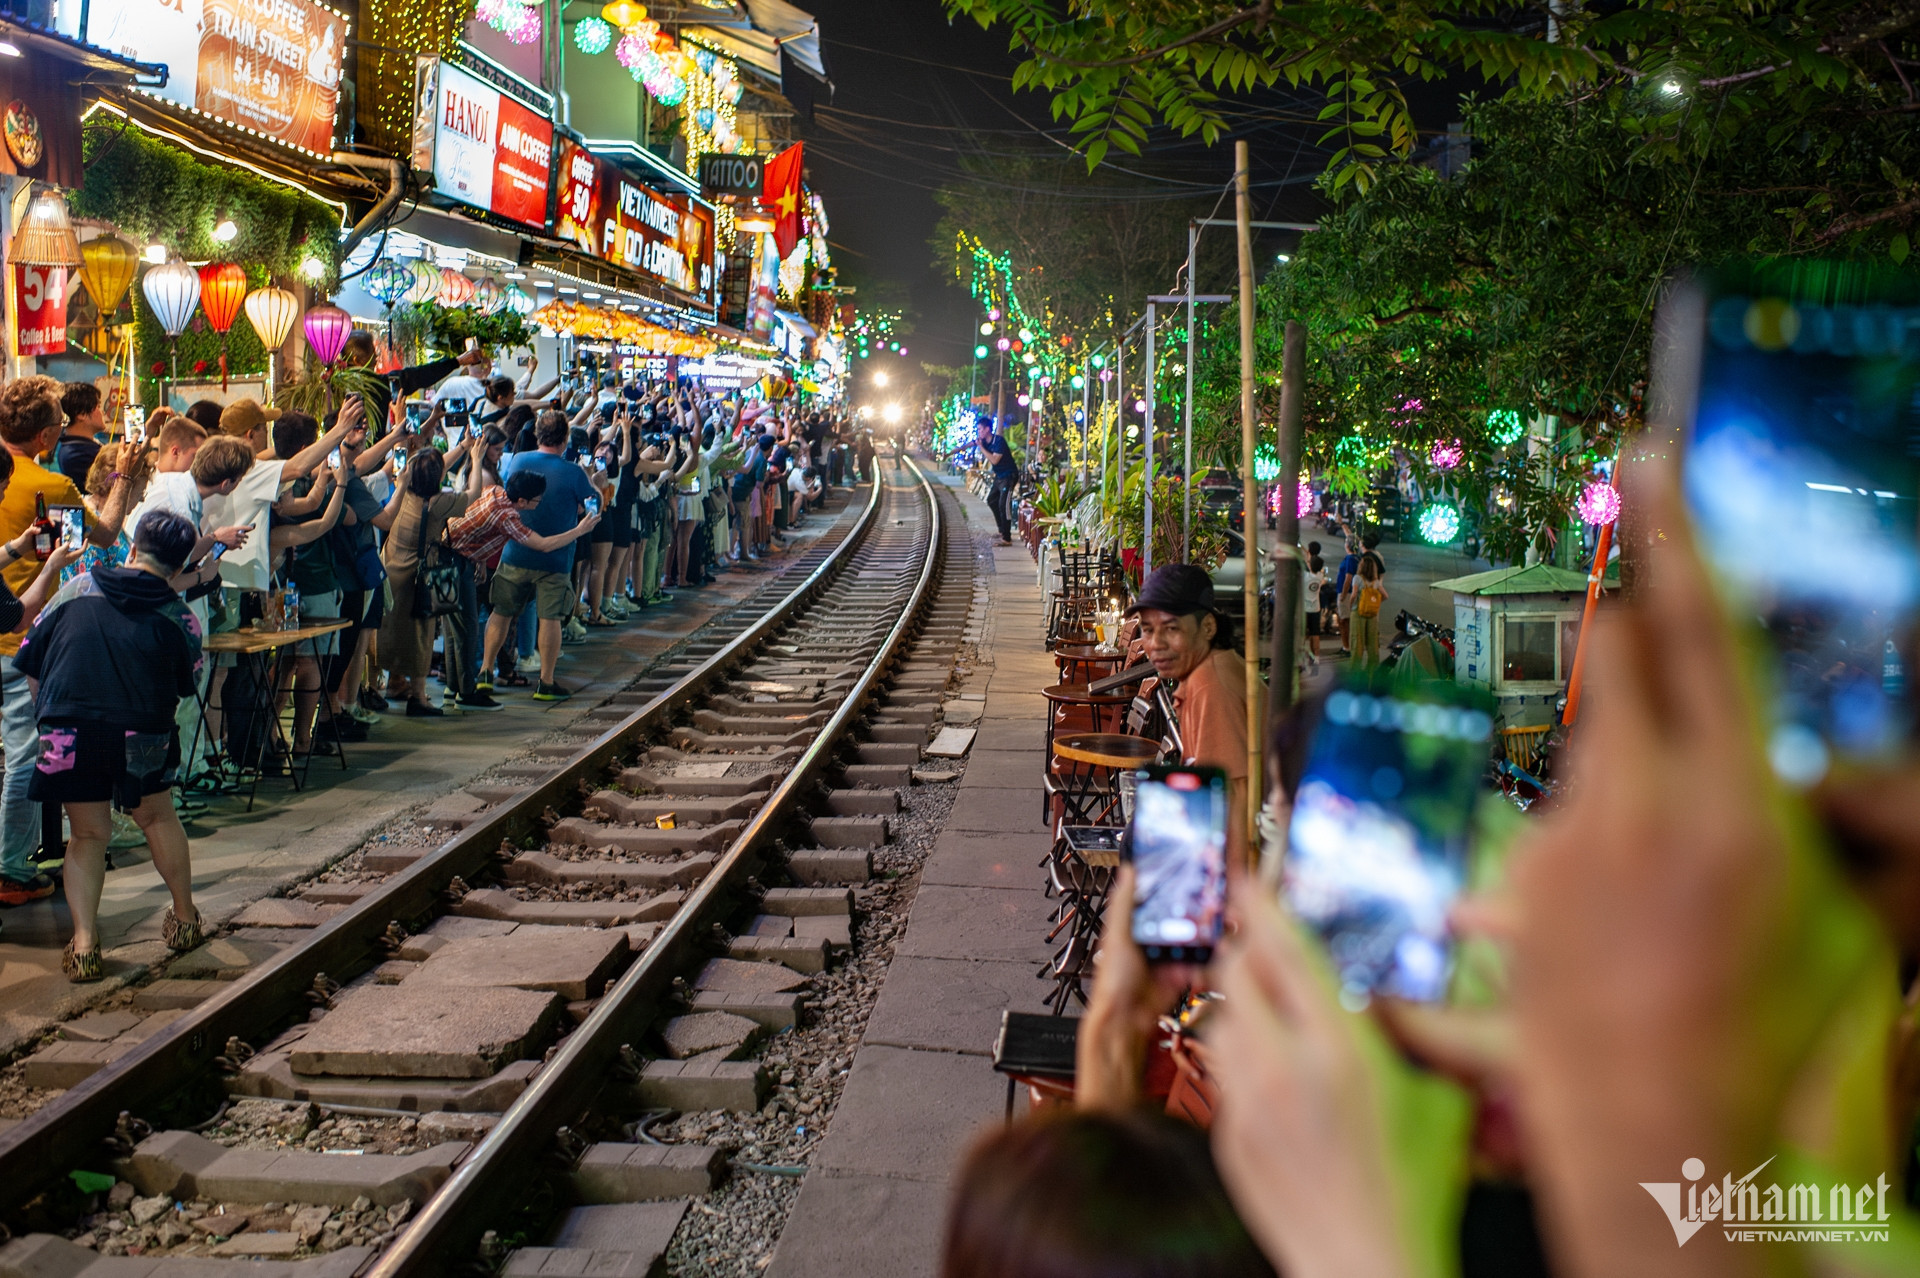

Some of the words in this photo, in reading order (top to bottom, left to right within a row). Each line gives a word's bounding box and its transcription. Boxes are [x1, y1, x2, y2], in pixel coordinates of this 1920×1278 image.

[253, 0, 306, 34] COFFEE
[213, 6, 257, 50] TRAIN
[257, 29, 307, 71] STREET
[232, 54, 251, 86] 54
[262, 69, 280, 98] 58
[444, 89, 490, 144] HANOI
[520, 133, 551, 169] COFFEE
[704, 158, 759, 188] TATTOO
[572, 183, 590, 222] 50
[620, 180, 680, 239] VIETNAMESE
[643, 243, 651, 270] &
[24, 265, 63, 312] 54
[20, 327, 44, 346] Coffee
[45, 326, 51, 343] &
[52, 325, 65, 343] Beer
